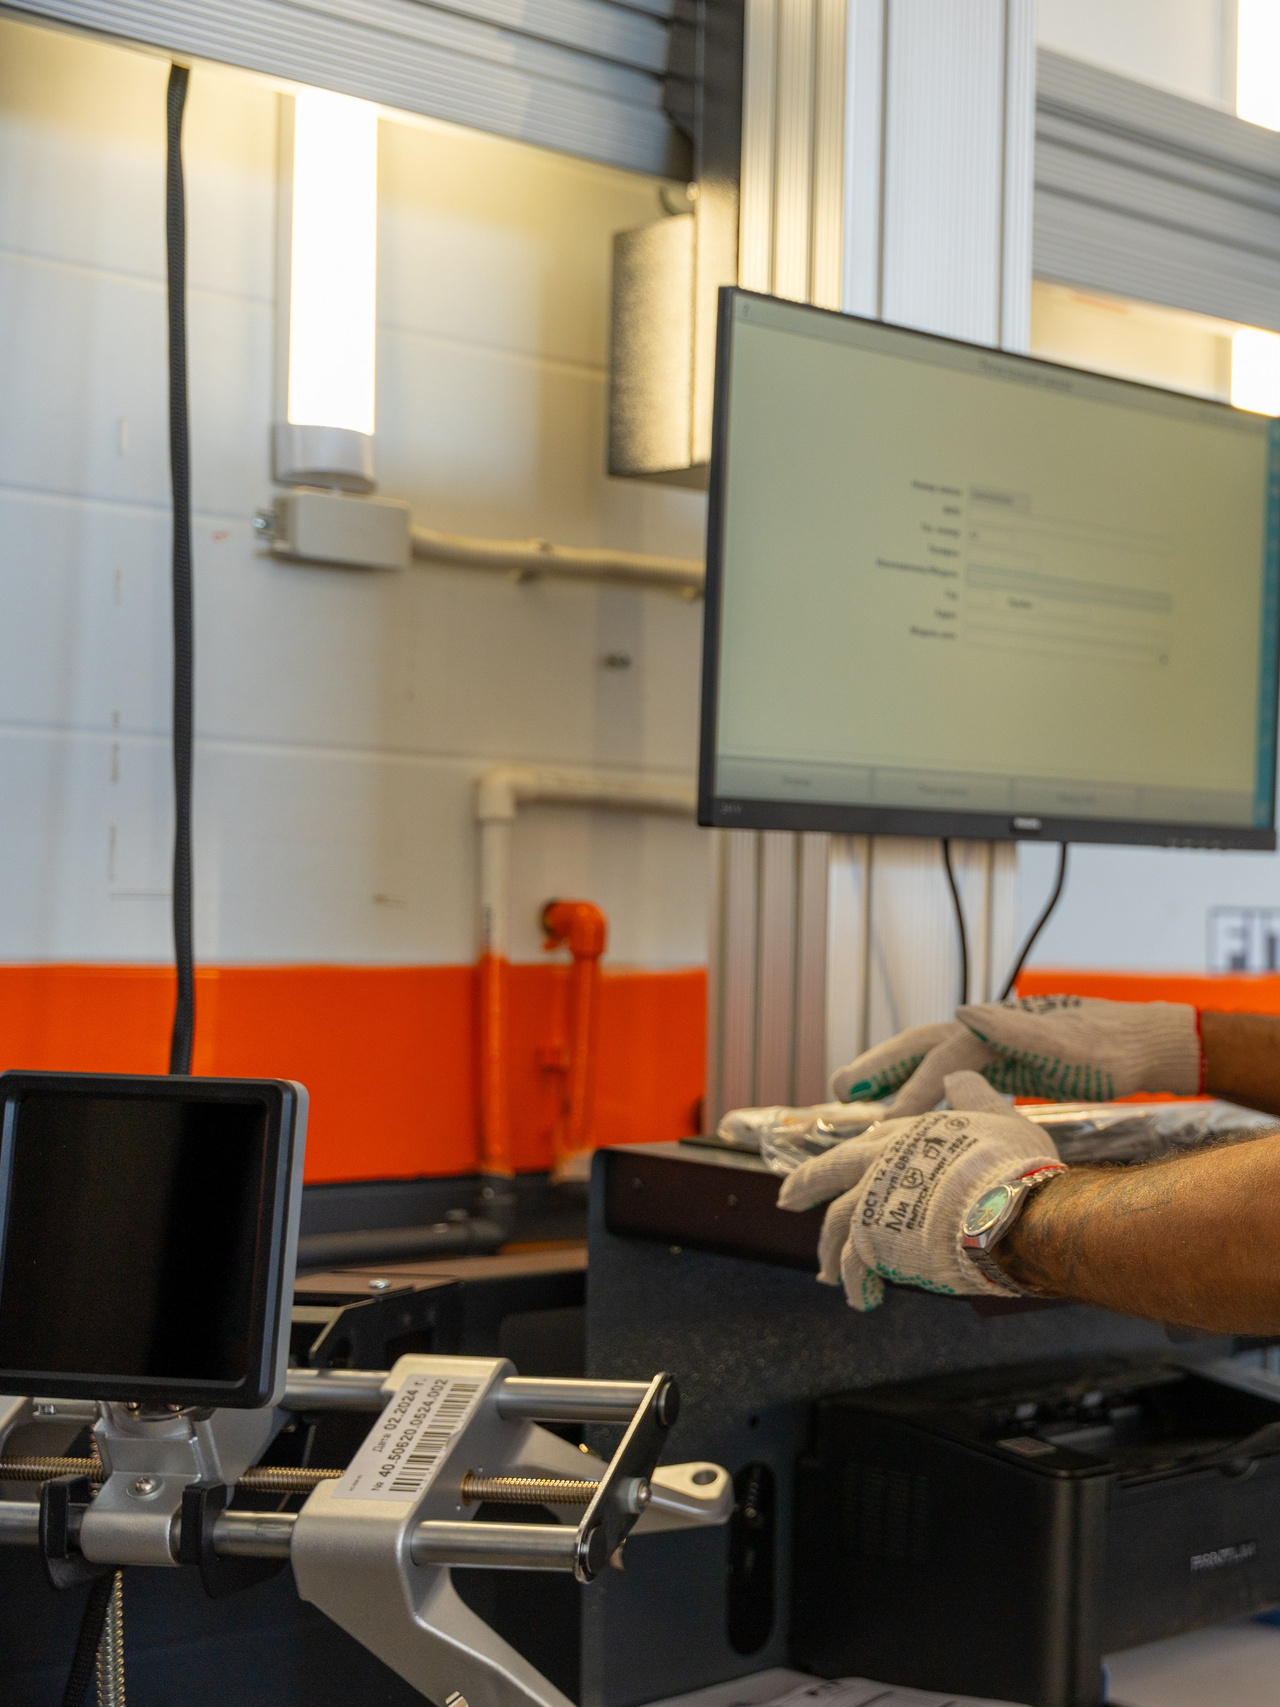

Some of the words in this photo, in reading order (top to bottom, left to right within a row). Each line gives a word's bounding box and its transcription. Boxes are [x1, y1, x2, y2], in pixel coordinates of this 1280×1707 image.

[861, 1191, 877, 1227] ГОСТ
[372, 1434, 392, 1453] Дата
[384, 1388, 418, 1431] 02.2024
[379, 1379, 448, 1478] 40.50620.0524.002
